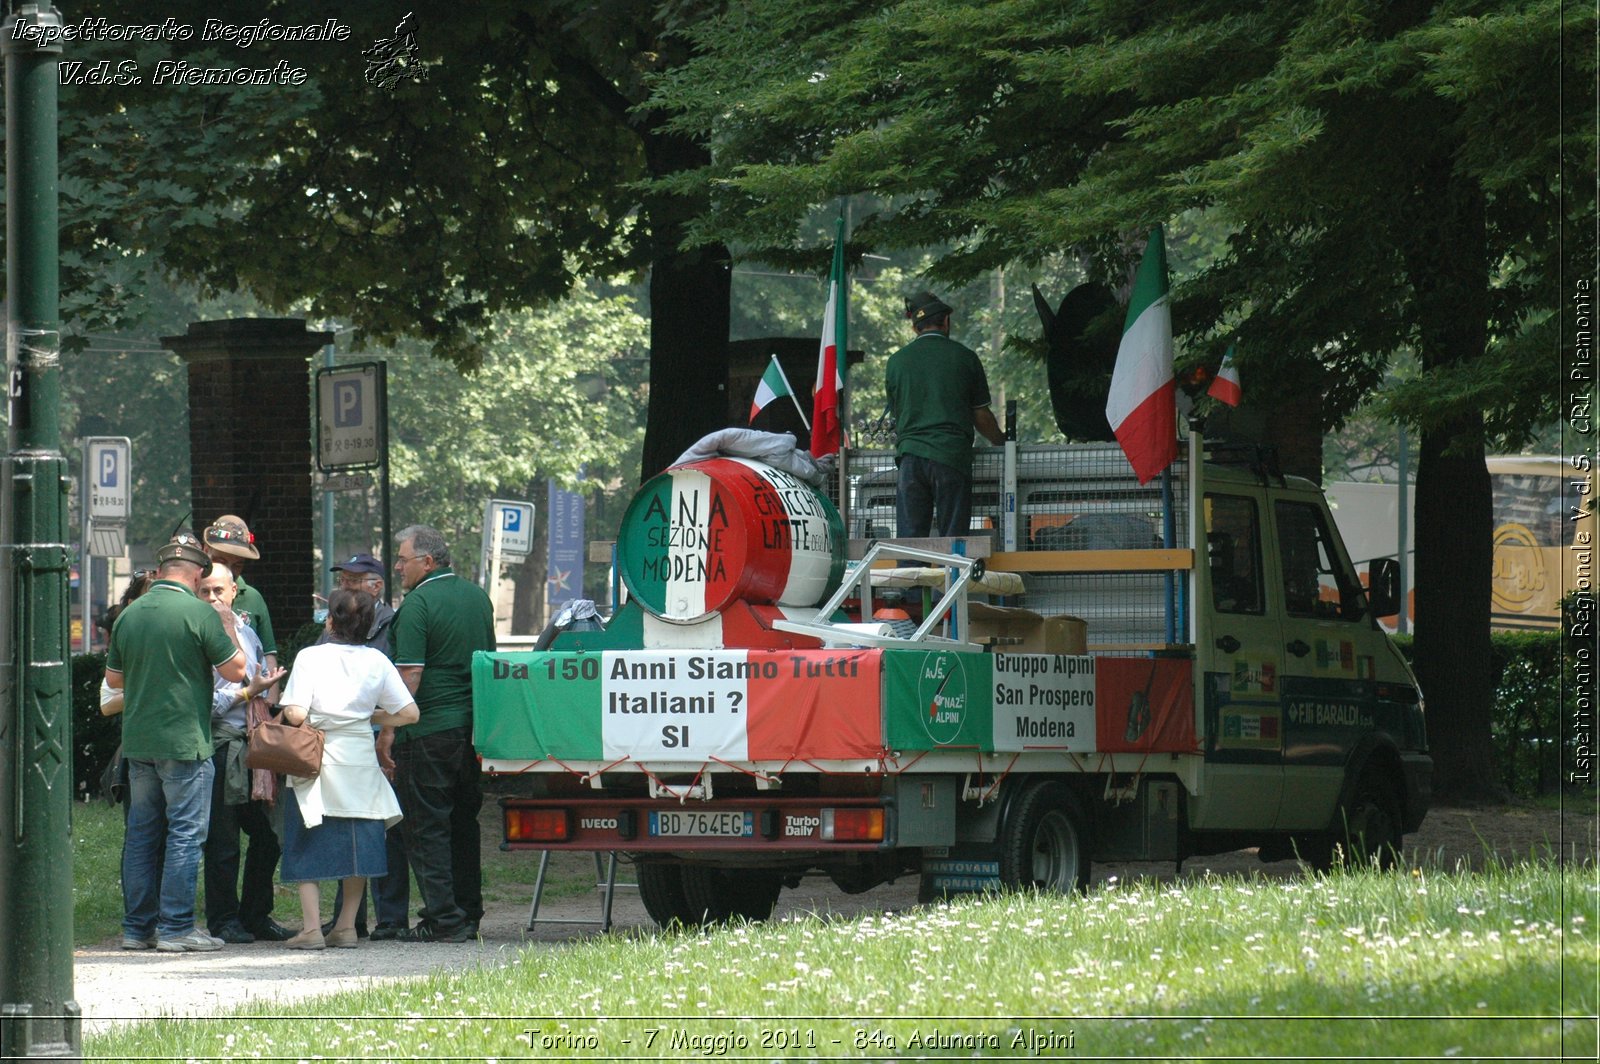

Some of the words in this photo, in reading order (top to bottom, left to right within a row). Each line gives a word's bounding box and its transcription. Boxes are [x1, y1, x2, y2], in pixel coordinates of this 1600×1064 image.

[647, 526, 724, 552] SEZIONE
[762, 519, 810, 550] LATTE
[642, 553, 727, 583] MODENA
[492, 659, 529, 680] Da
[543, 658, 599, 680] 150
[610, 657, 675, 680] Anni
[687, 657, 778, 680] Siamo
[790, 656, 859, 679] Tutti
[995, 653, 1048, 678] Gruppo
[1053, 655, 1095, 679] Alpini
[609, 691, 716, 714] Italiani
[727, 691, 743, 713] ?
[996, 683, 1023, 705] San
[1029, 684, 1095, 710] Prospero
[935, 712, 960, 723] ALPINI
[1316, 704, 1359, 726] BARALDI
[661, 725, 689, 748] SI
[1016, 717, 1075, 737] Modena
[581, 819, 618, 829] IVECO
[784, 825, 813, 837] Daily
[785, 815, 820, 826] Turbo
